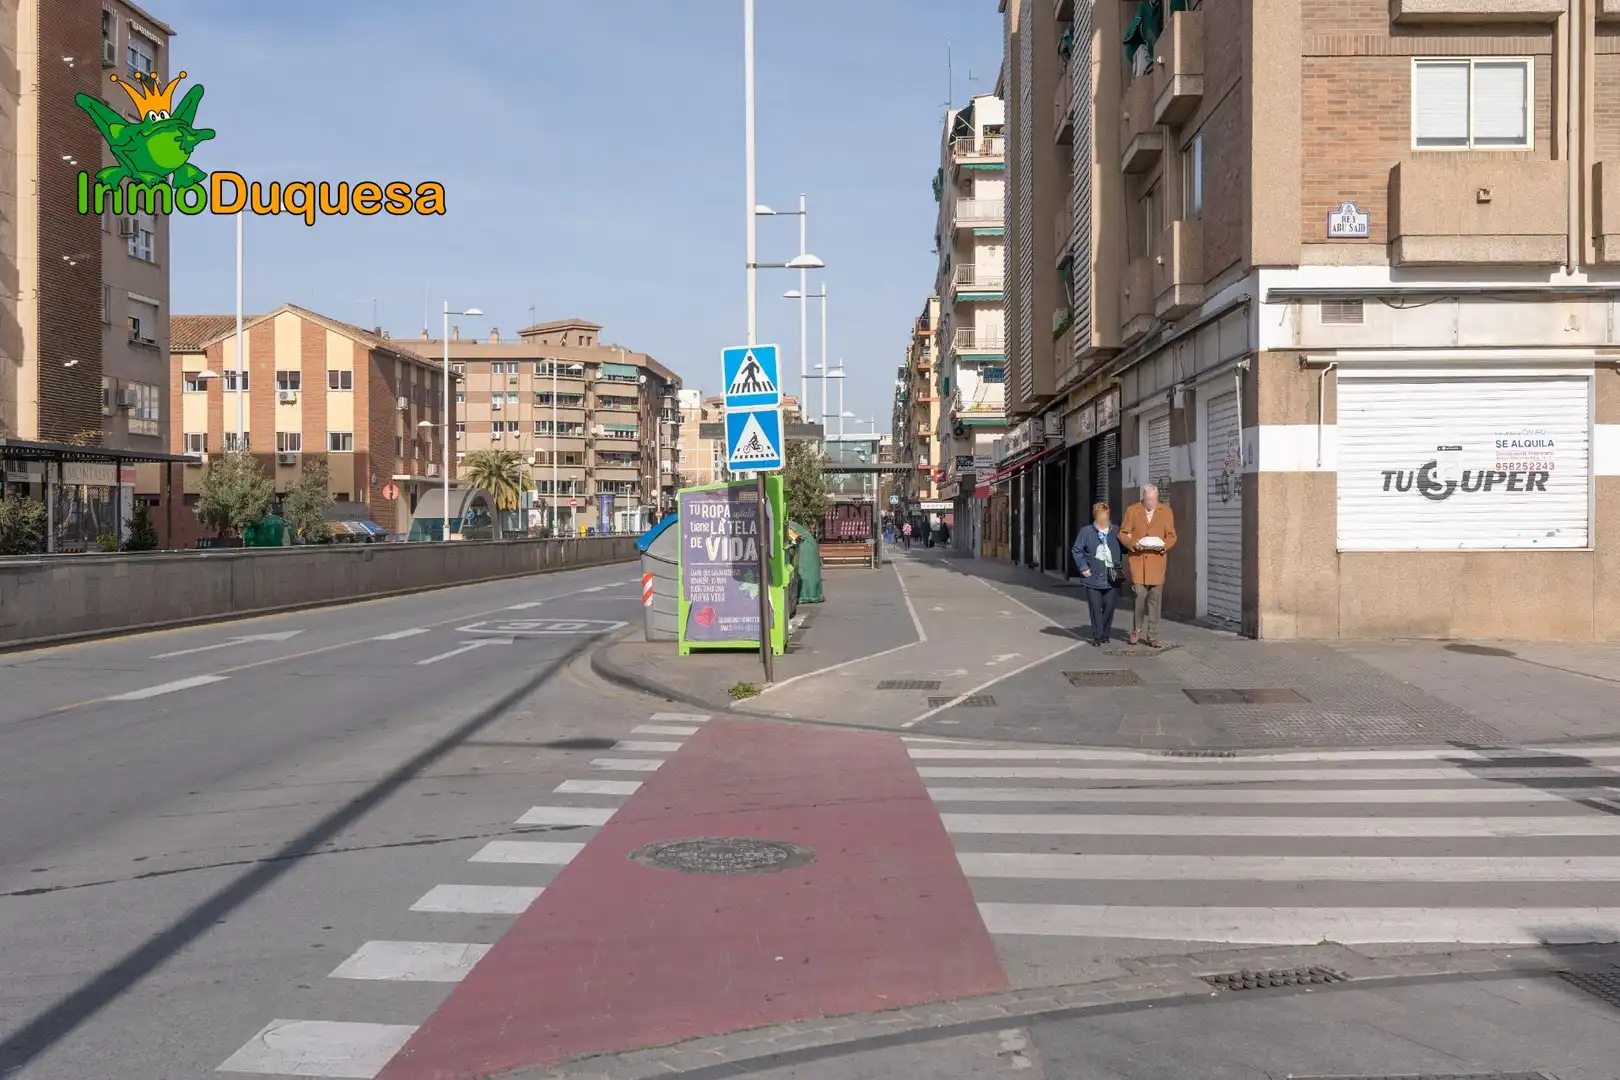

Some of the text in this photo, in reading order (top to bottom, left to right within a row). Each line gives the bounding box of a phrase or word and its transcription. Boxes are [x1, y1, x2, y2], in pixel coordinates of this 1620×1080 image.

[1341, 215, 1356, 223] REY
[1332, 223, 1366, 232] ABU SAID
[1495, 439, 1554, 448] SE ALQUILA
[1495, 462, 1555, 471] 958252243
[1381, 470, 1414, 492] TU
[689, 504, 700, 515] TU
[701, 504, 731, 518] ROPA
[690, 520, 757, 535] tiene LA TELA
[690, 536, 759, 562] DE VIDA
